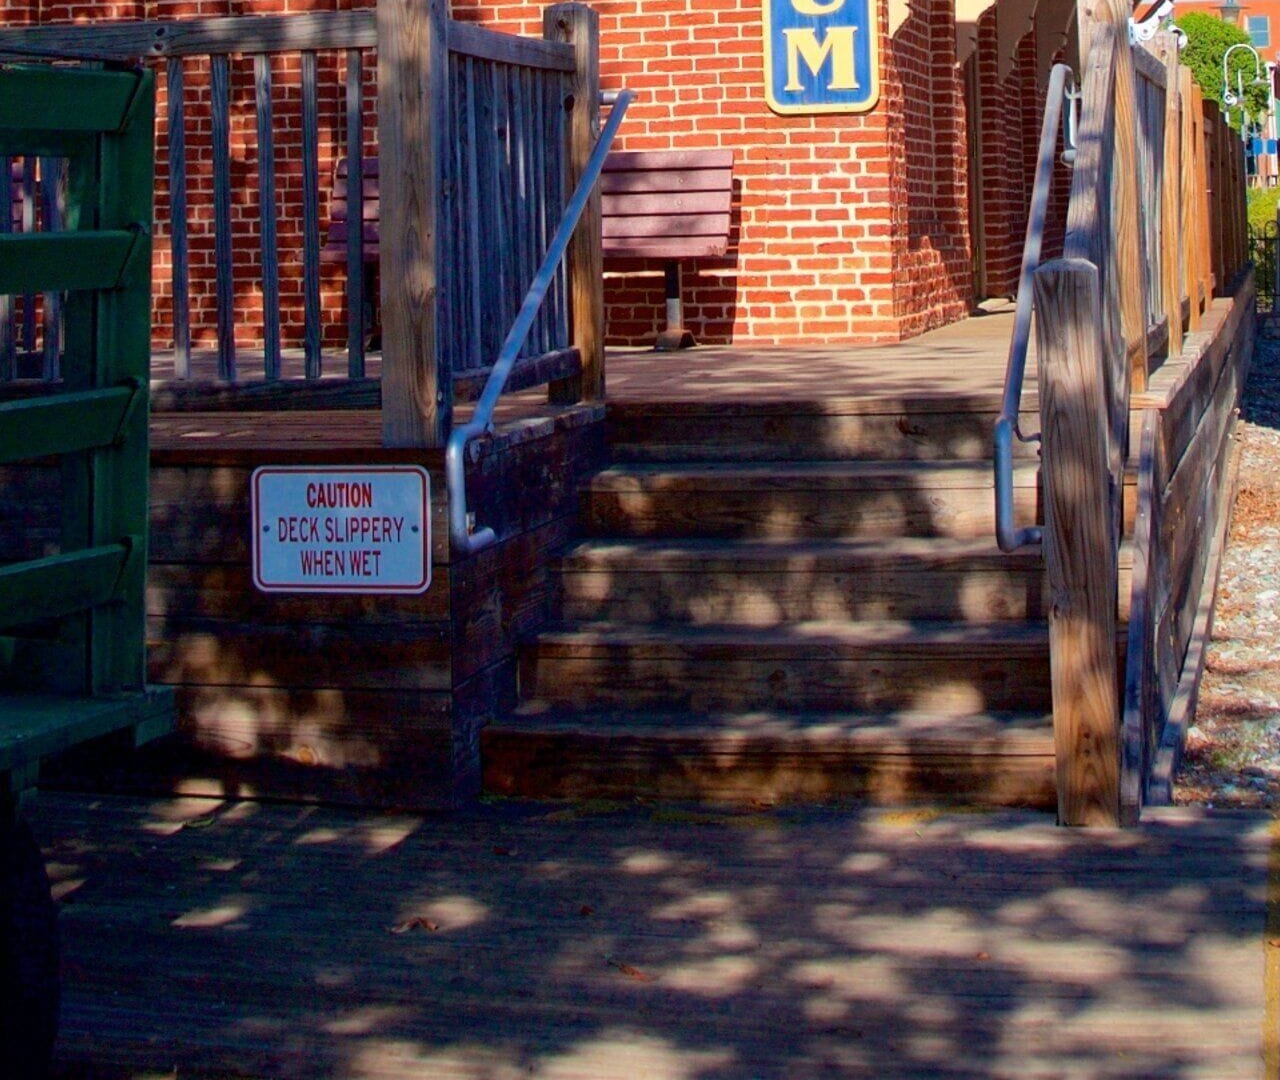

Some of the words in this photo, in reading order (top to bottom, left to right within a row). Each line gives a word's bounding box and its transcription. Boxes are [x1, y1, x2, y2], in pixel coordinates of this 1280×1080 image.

[306, 482, 372, 509] CAUTION
[278, 516, 320, 543] DECK
[325, 516, 405, 543] SLIPPERY
[300, 550, 345, 577] WHEN
[349, 550, 381, 577] WET
